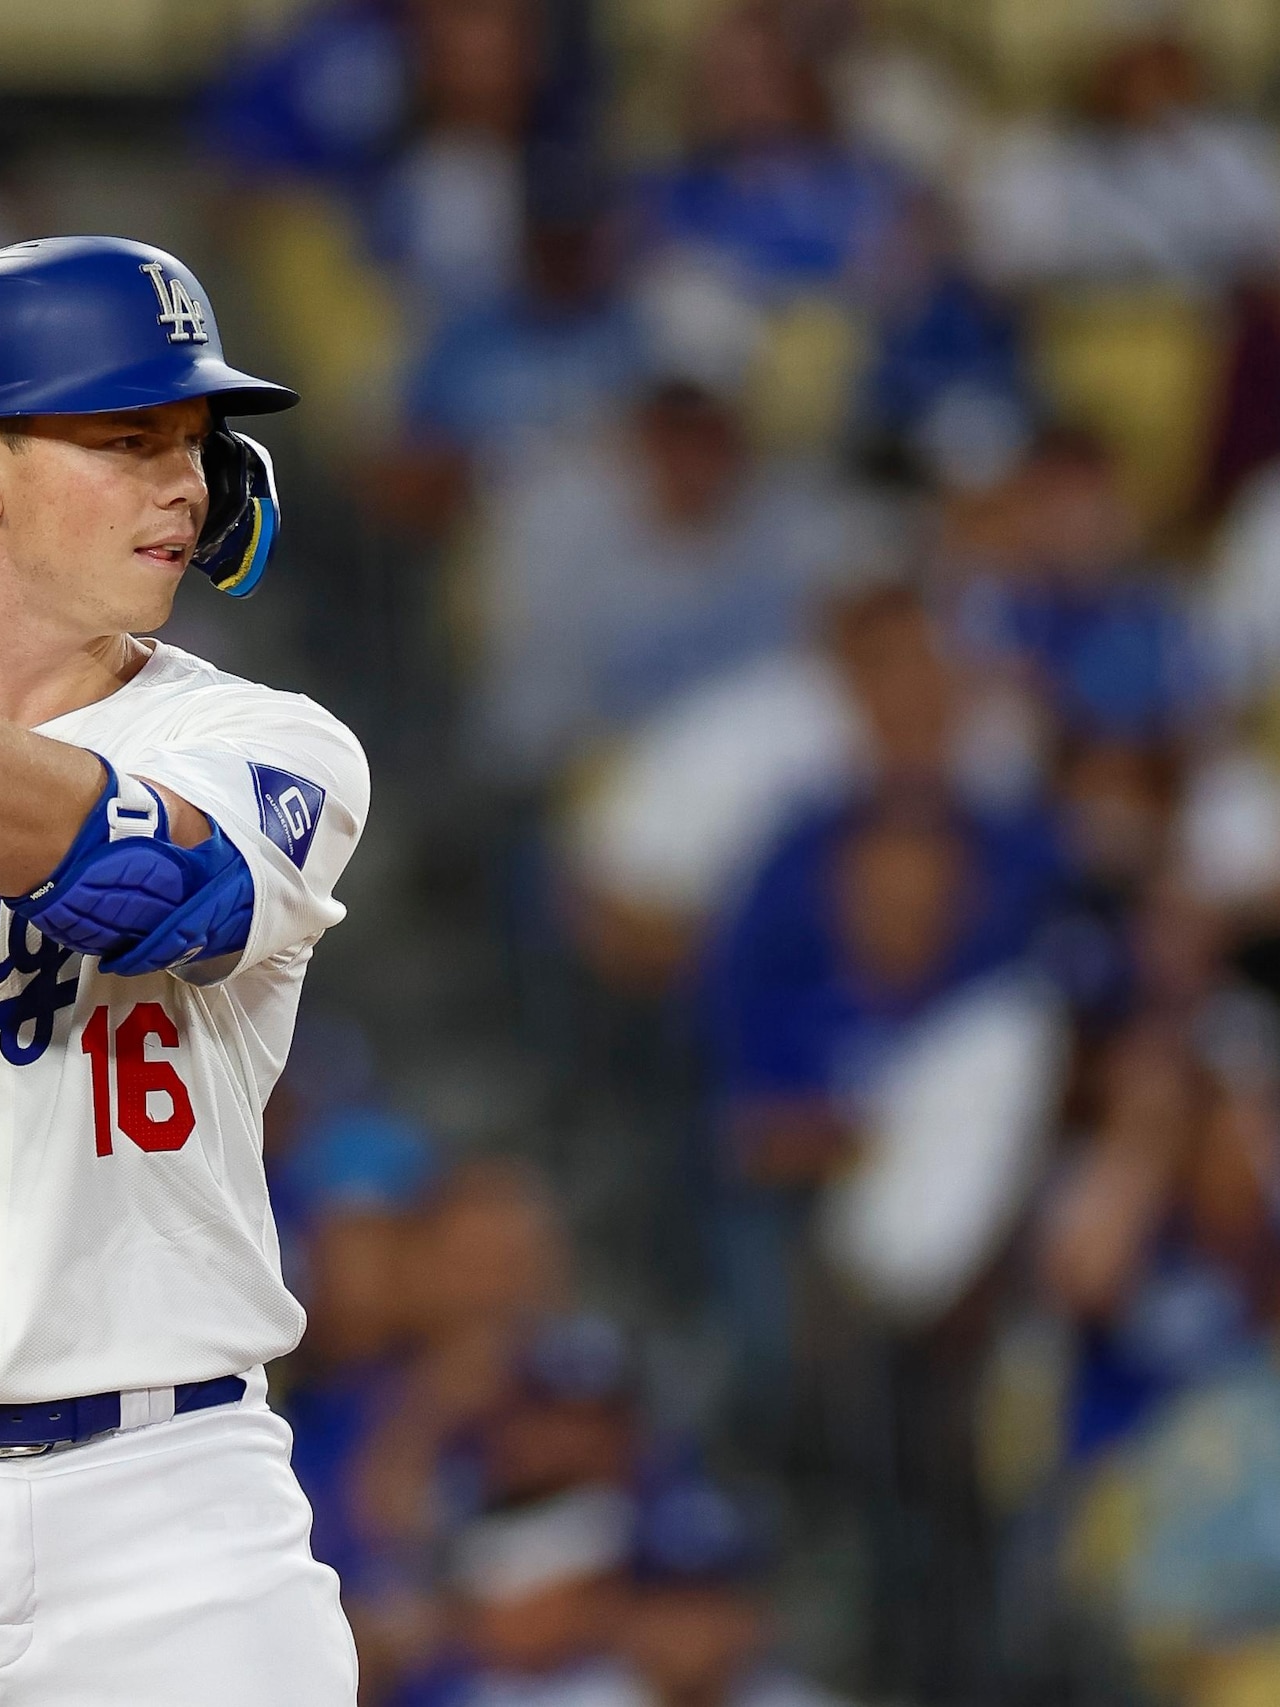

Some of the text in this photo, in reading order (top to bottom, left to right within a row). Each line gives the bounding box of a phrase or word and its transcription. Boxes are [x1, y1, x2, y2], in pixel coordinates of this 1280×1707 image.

[139, 262, 208, 342] LA
[279, 786, 312, 840] G
[81, 1002, 196, 1157] 16
